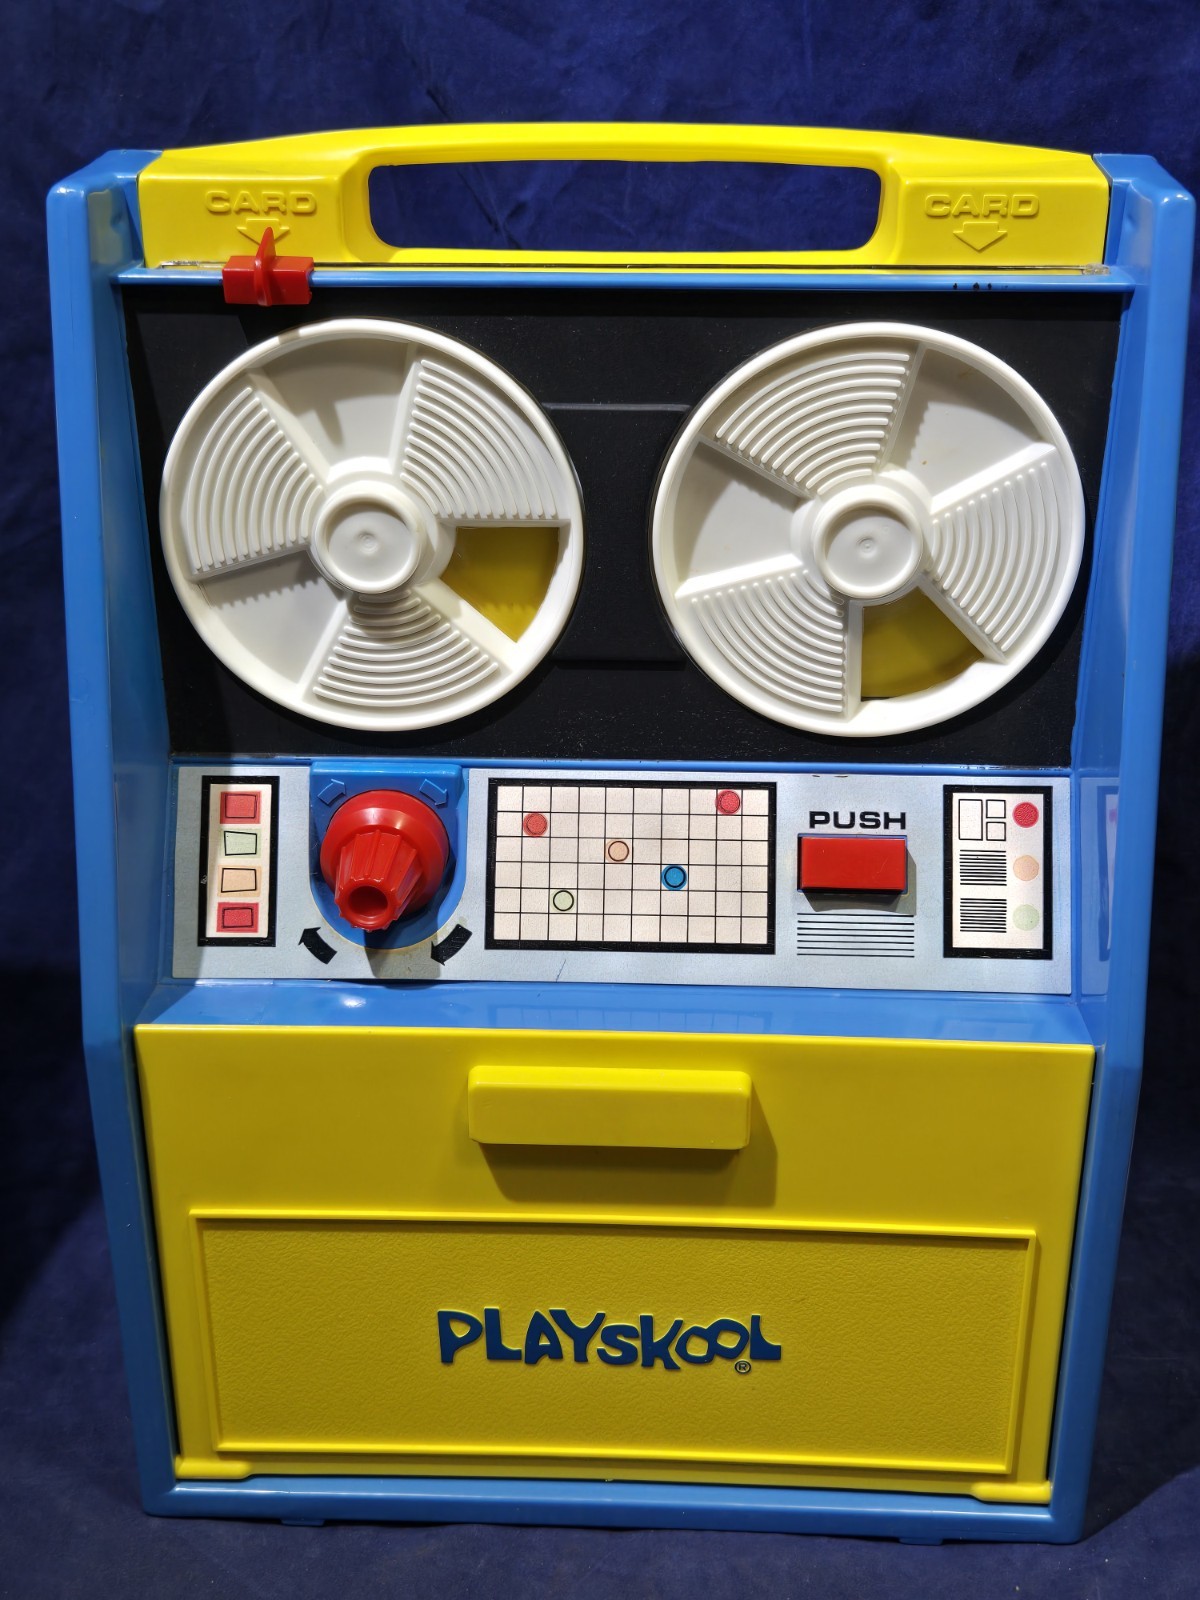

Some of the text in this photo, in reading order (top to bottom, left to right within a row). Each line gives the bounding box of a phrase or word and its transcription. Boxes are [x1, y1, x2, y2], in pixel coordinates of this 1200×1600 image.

[205, 190, 317, 215] CARD
[925, 194, 1039, 218] CARD
[809, 811, 906, 830] PUSH
[437, 1306, 782, 1370] PLAYSKOOL
